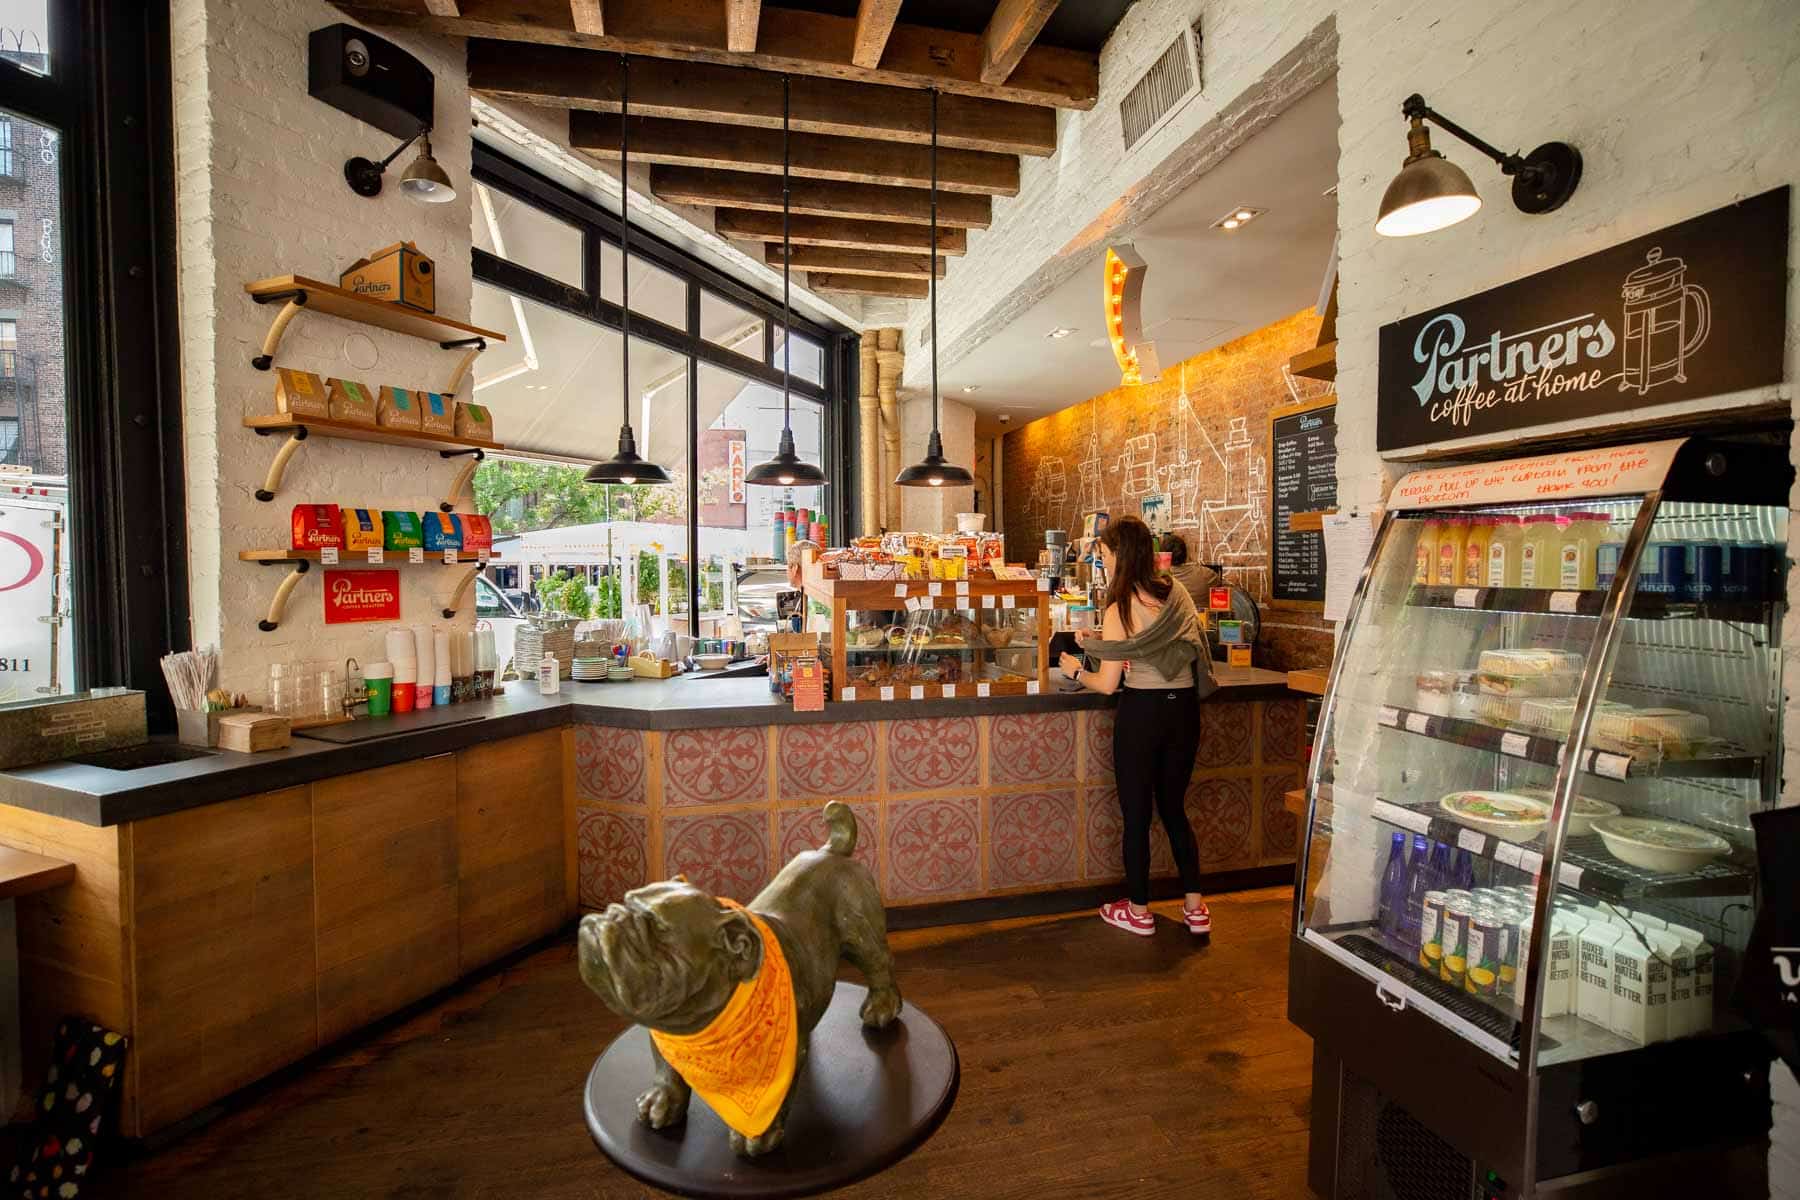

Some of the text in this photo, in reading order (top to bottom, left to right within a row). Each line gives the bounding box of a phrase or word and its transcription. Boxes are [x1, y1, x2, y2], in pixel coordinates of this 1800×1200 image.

[1412, 313, 1615, 406] Partners
[1430, 362, 1601, 425] coffee at home
[733, 442, 743, 491] PARK
[333, 579, 393, 607] Partners
[0, 657, 31, 672] 811
[1582, 940, 1604, 956] BOXED
[1581, 961, 1588, 971] IS
[1615, 952, 1638, 970] BOXED
[1614, 974, 1621, 985] IS
